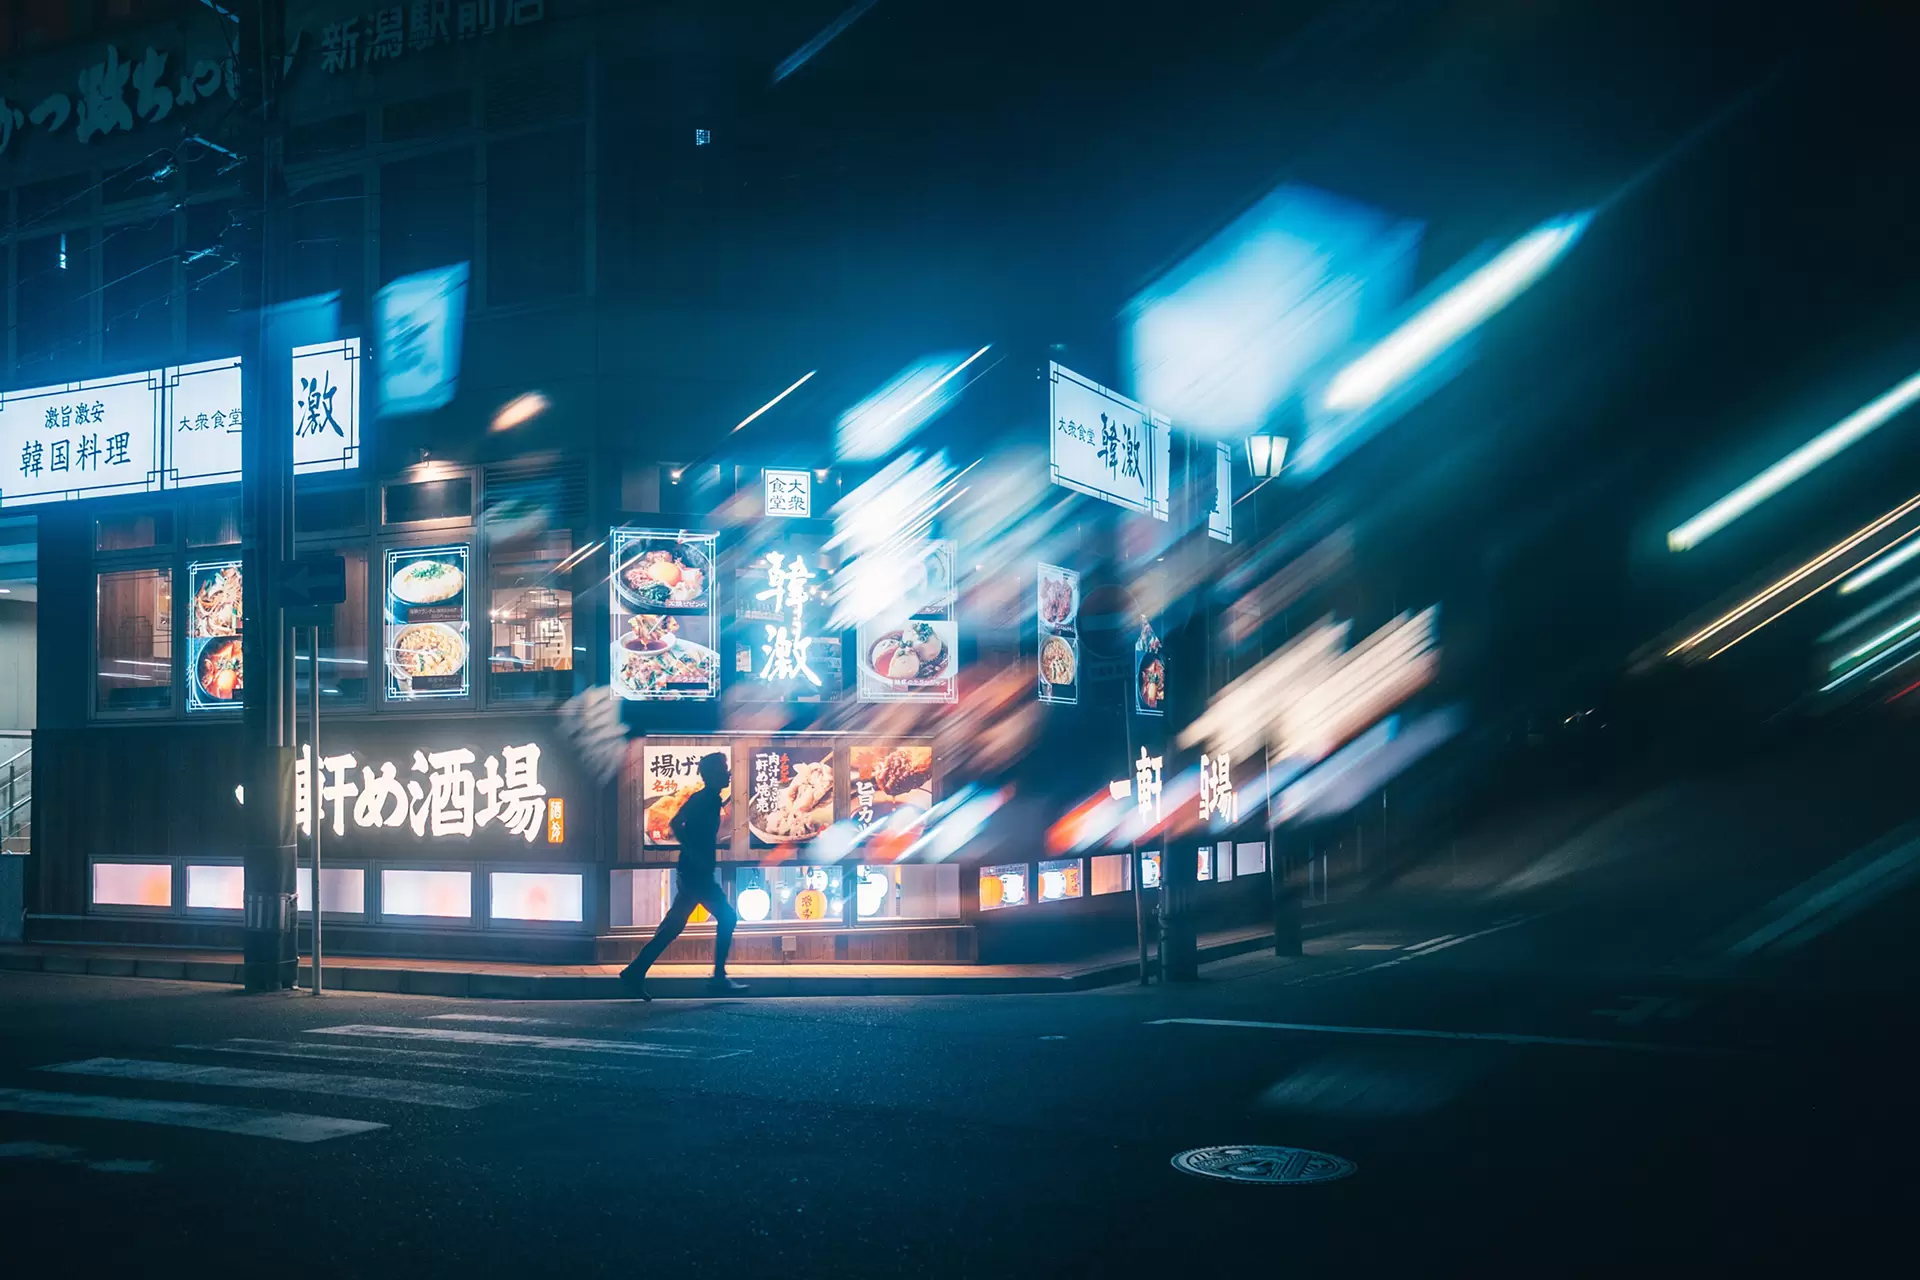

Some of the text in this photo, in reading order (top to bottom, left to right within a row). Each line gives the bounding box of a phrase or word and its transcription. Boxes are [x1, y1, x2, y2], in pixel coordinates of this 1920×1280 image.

[44, 400, 105, 428] 激旨激安
[178, 408, 242, 433] 大衆食堂
[19, 431, 131, 479] 韓国料理
[1058, 412, 1145, 488] 大衆食堂 韓激
[756, 551, 822, 687] 韓激
[650, 754, 702, 778] 揚げ
[235, 743, 547, 843] 軒め酒場
[652, 779, 678, 792] 名物
